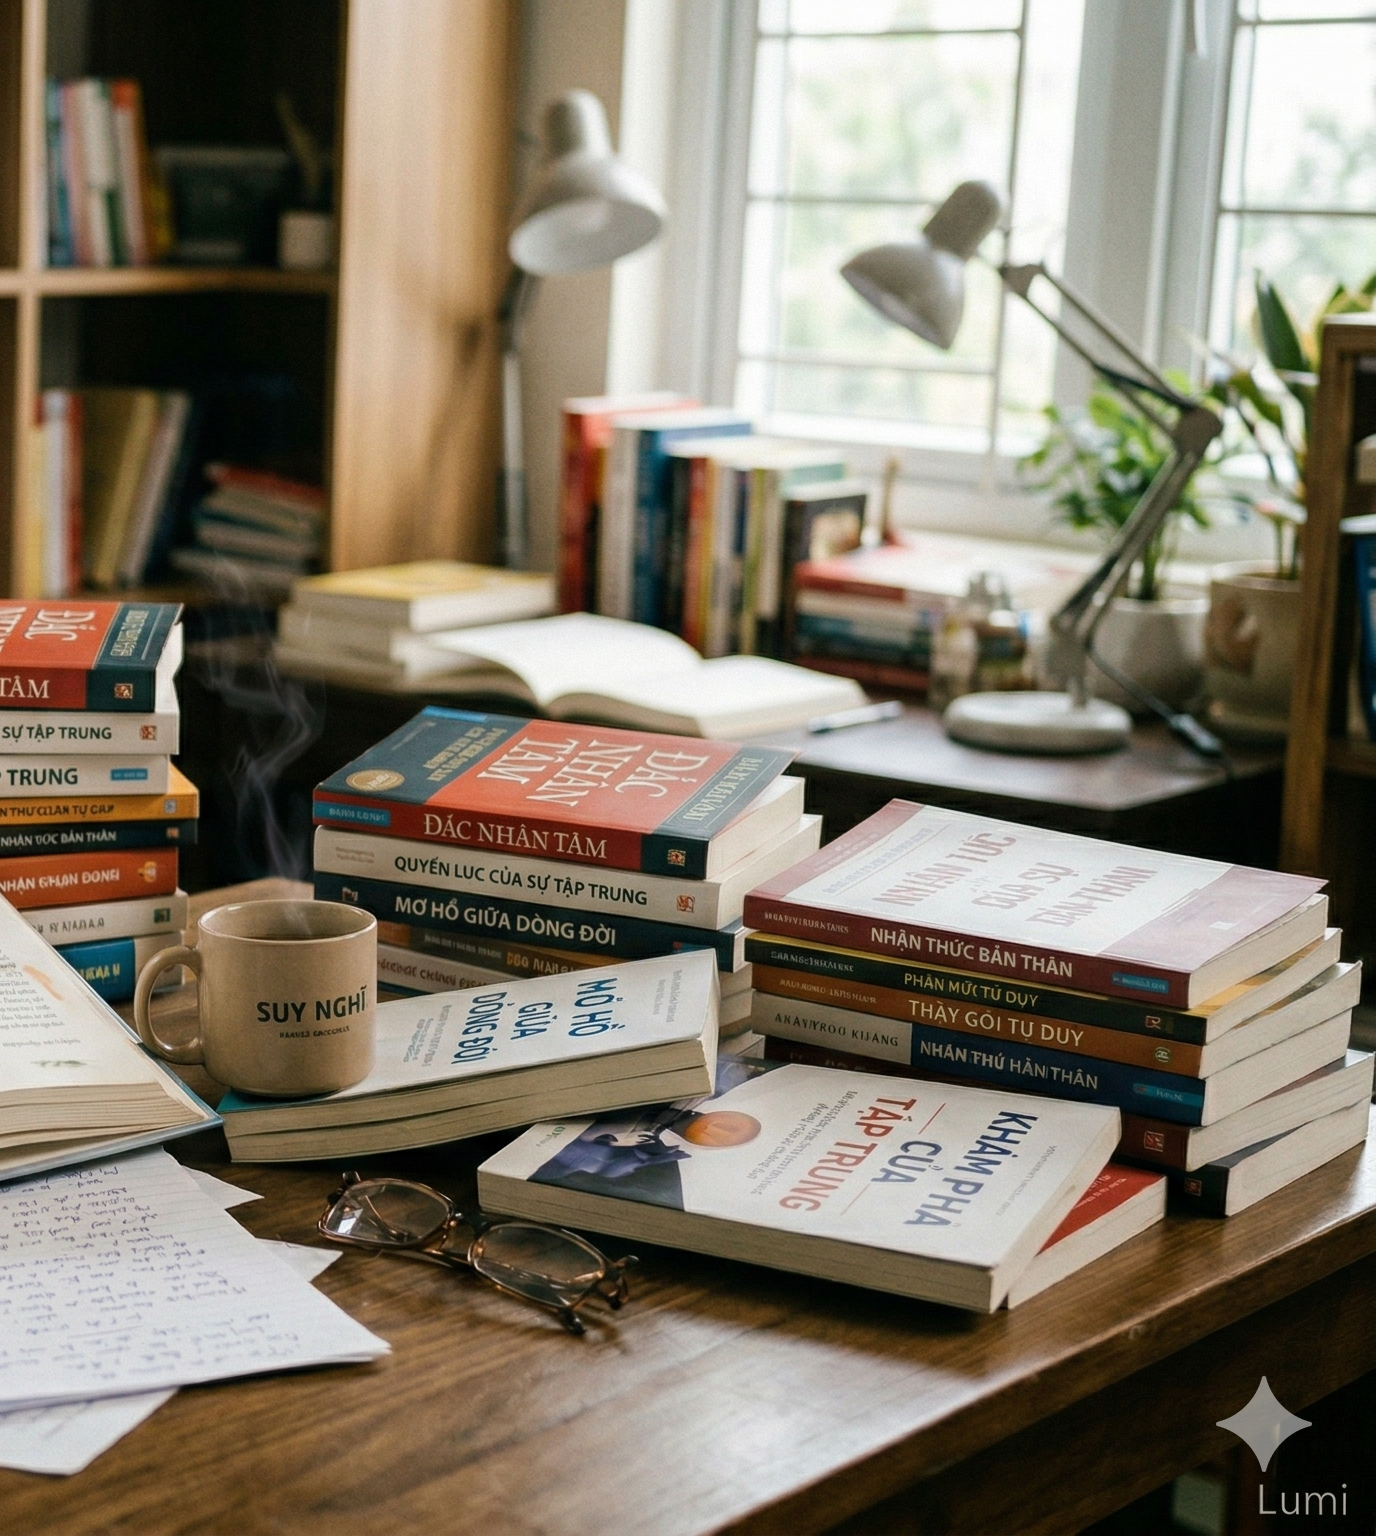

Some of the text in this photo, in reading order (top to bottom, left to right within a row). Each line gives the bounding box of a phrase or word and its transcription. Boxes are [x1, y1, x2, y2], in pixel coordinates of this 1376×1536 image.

[2, 724, 23, 743] SỰ
[26, 723, 55, 743] TẬP
[59, 726, 112, 740] TRUNG
[7, 768, 78, 787] TRUNG
[477, 737, 580, 785] TÂM
[525, 739, 644, 807] NHÂN
[477, 821, 550, 851] NHÂN
[455, 864, 485, 882] LUC
[489, 866, 523, 887] CỦA
[527, 874, 552, 895] SỰ
[554, 876, 585, 898] TẬP
[588, 883, 647, 906] TRUNG
[395, 896, 427, 916] MƠ
[516, 913, 575, 941] DÒNG
[579, 923, 616, 946] ĐỜI
[925, 936, 975, 960] THỨC
[256, 985, 367, 1023] SUY NGHĨ
[1041, 1023, 1084, 1047] DUY
[779, 1141, 878, 1212] TRUNG
